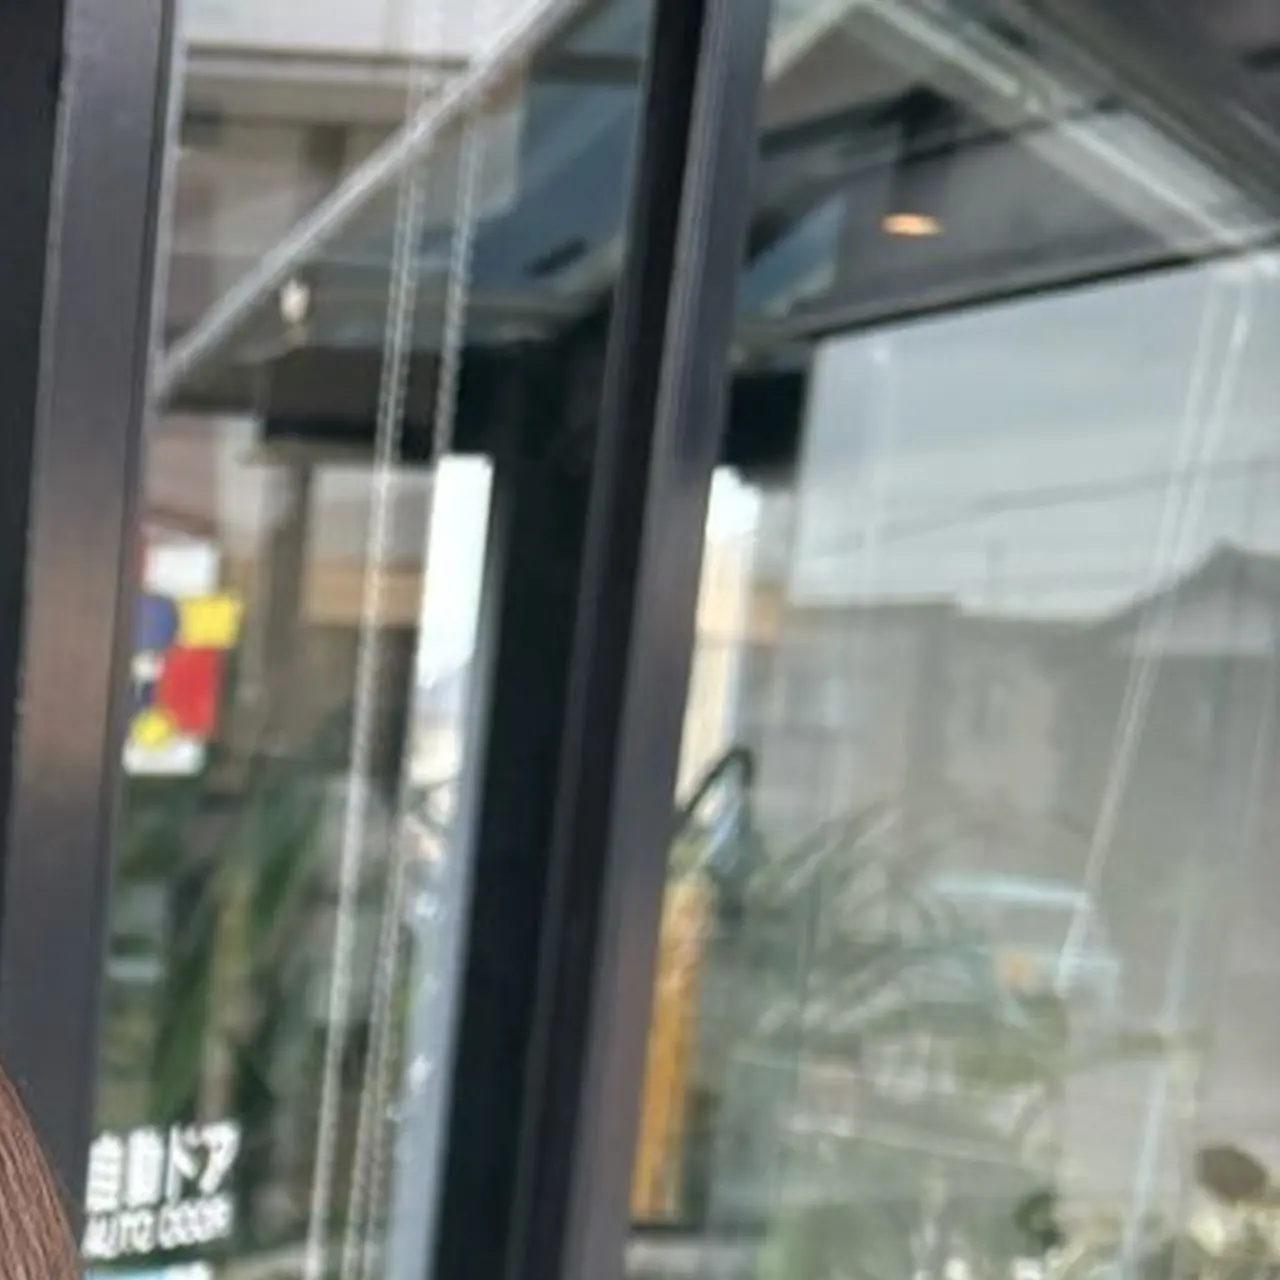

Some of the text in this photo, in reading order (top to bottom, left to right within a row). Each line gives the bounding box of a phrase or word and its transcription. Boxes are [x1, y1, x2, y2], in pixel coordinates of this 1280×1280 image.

[87, 1123, 240, 1211] 自動ドア
[83, 1197, 230, 1257] AUTO DOOR
